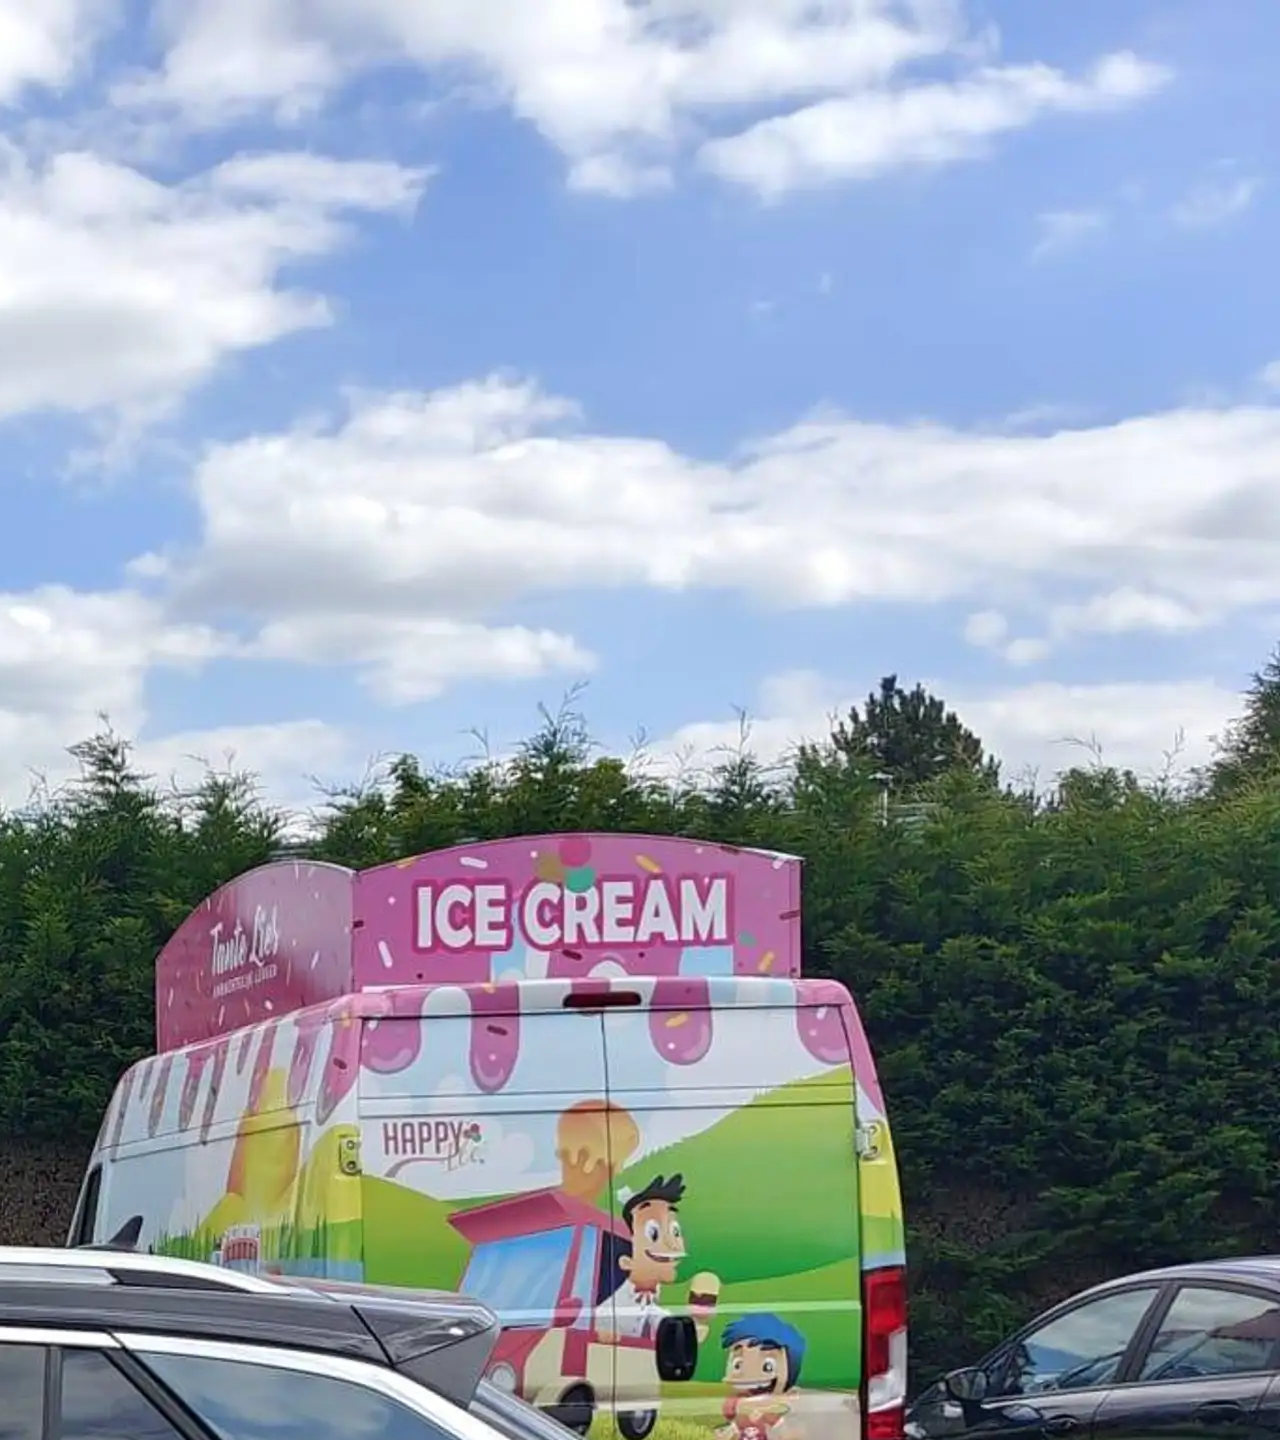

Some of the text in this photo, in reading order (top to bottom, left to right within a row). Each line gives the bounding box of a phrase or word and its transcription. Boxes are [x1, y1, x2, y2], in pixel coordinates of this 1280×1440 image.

[417, 878, 727, 948] ICE CREAM
[383, 1120, 464, 1157] HAPPY
